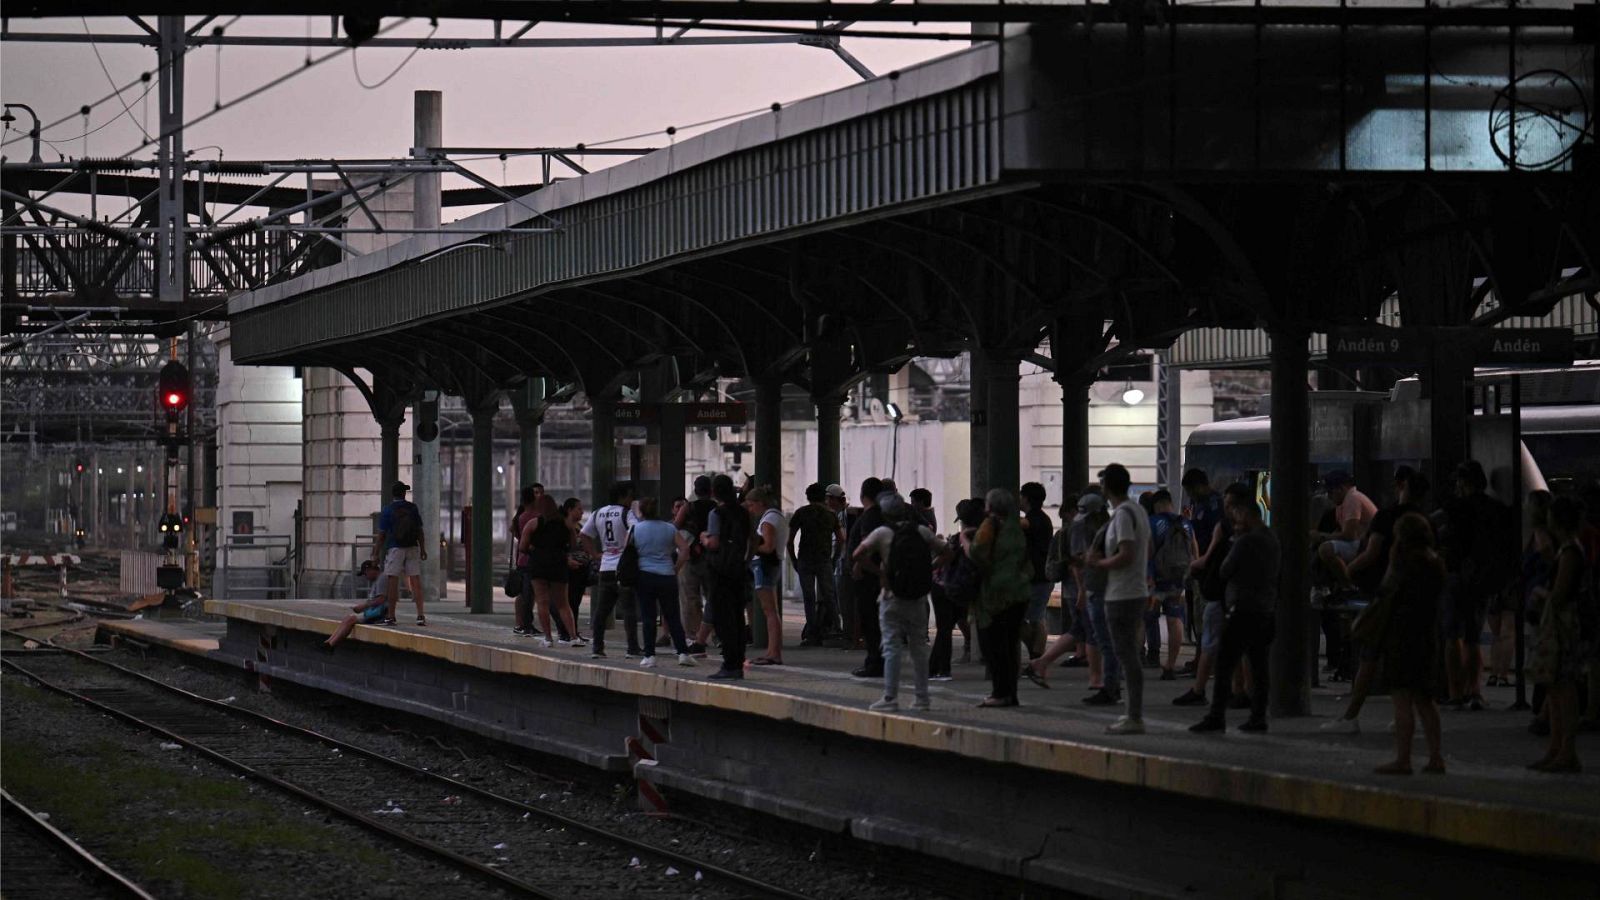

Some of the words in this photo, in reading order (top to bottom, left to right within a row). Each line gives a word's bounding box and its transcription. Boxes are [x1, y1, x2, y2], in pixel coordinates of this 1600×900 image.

[1336, 337, 1385, 352] Andén
[1389, 338, 1399, 353] 9
[1492, 338, 1541, 352] Andén
[615, 408, 632, 419] dén
[697, 409, 727, 419] Andén
[605, 520, 614, 541] 8
